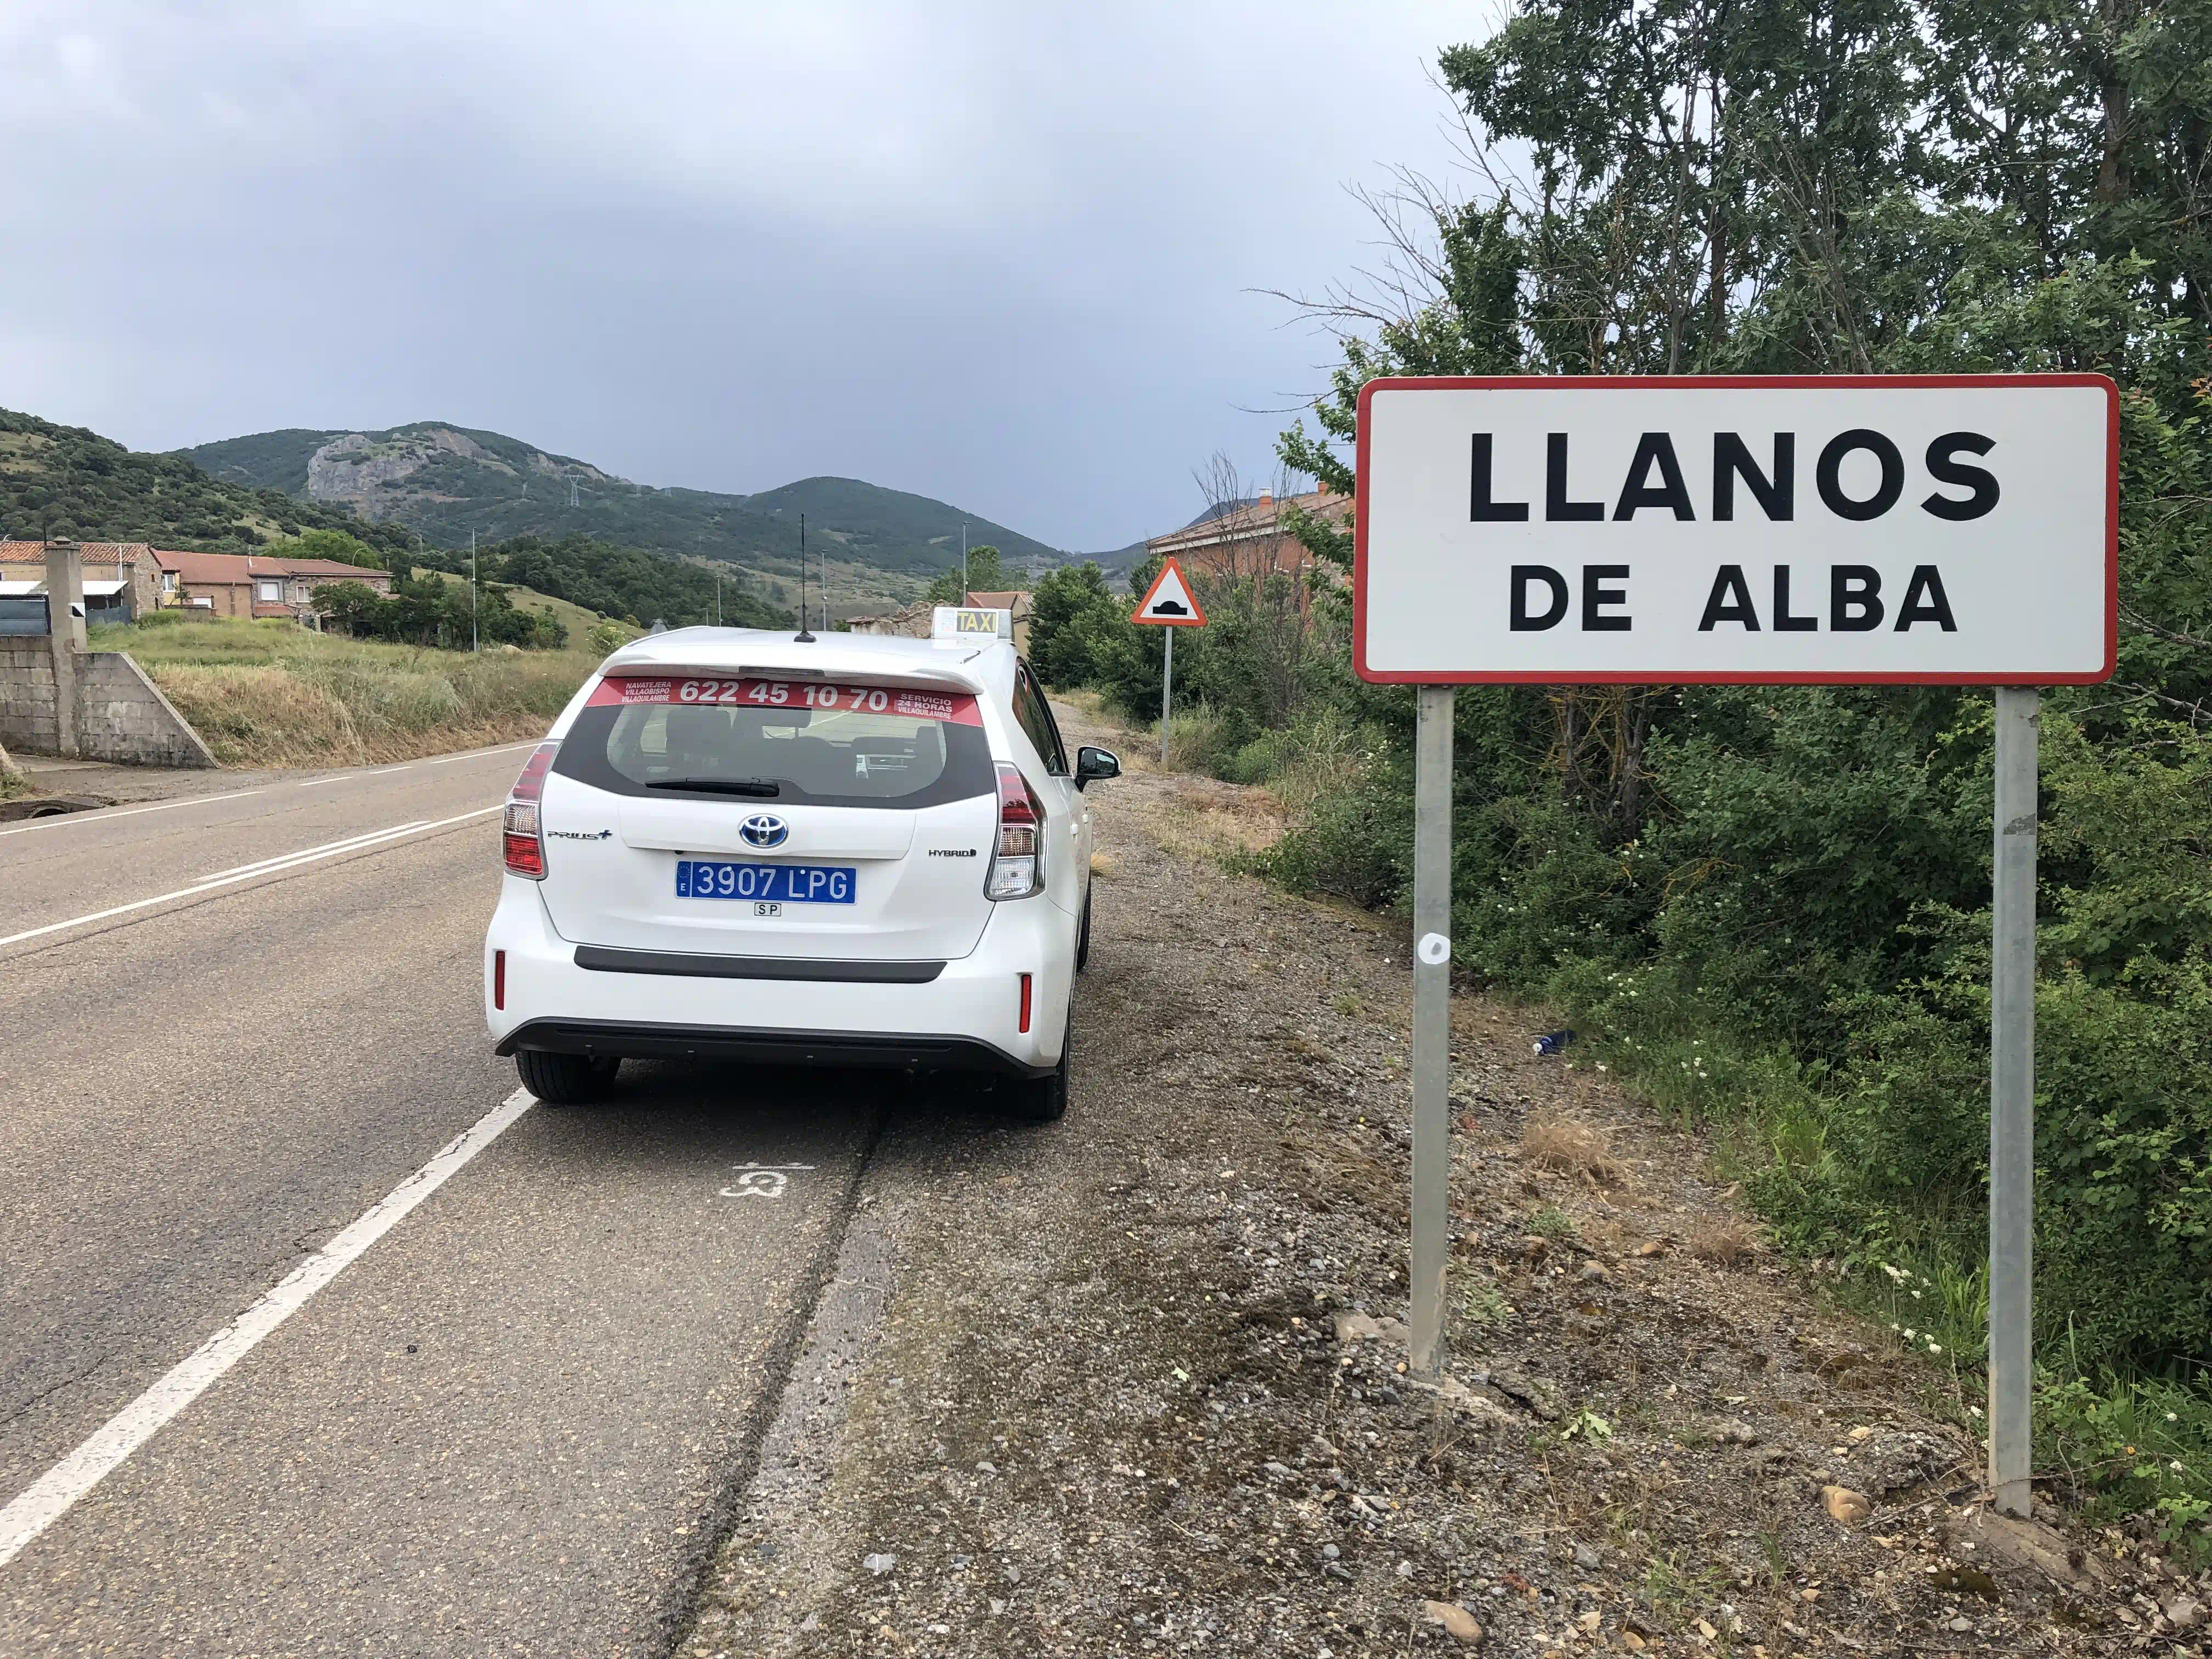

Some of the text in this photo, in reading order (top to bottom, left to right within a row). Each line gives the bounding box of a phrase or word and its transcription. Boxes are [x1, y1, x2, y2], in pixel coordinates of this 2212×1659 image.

[1470, 428, 2001, 522] LLANOS
[1509, 565, 1958, 632] DE ALBA
[957, 612, 996, 631] TAXI
[622, 694, 669, 703] VILLAQUILAMBRE
[625, 687, 670, 696] VILLAOBISPO
[680, 681, 888, 711] 622 45 10 70
[900, 693, 951, 706] SERVICIO
[898, 706, 951, 719] VILLAQUILAMBRE
[915, 702, 953, 713] HORAS
[697, 866, 847, 900] 3907 LPG
